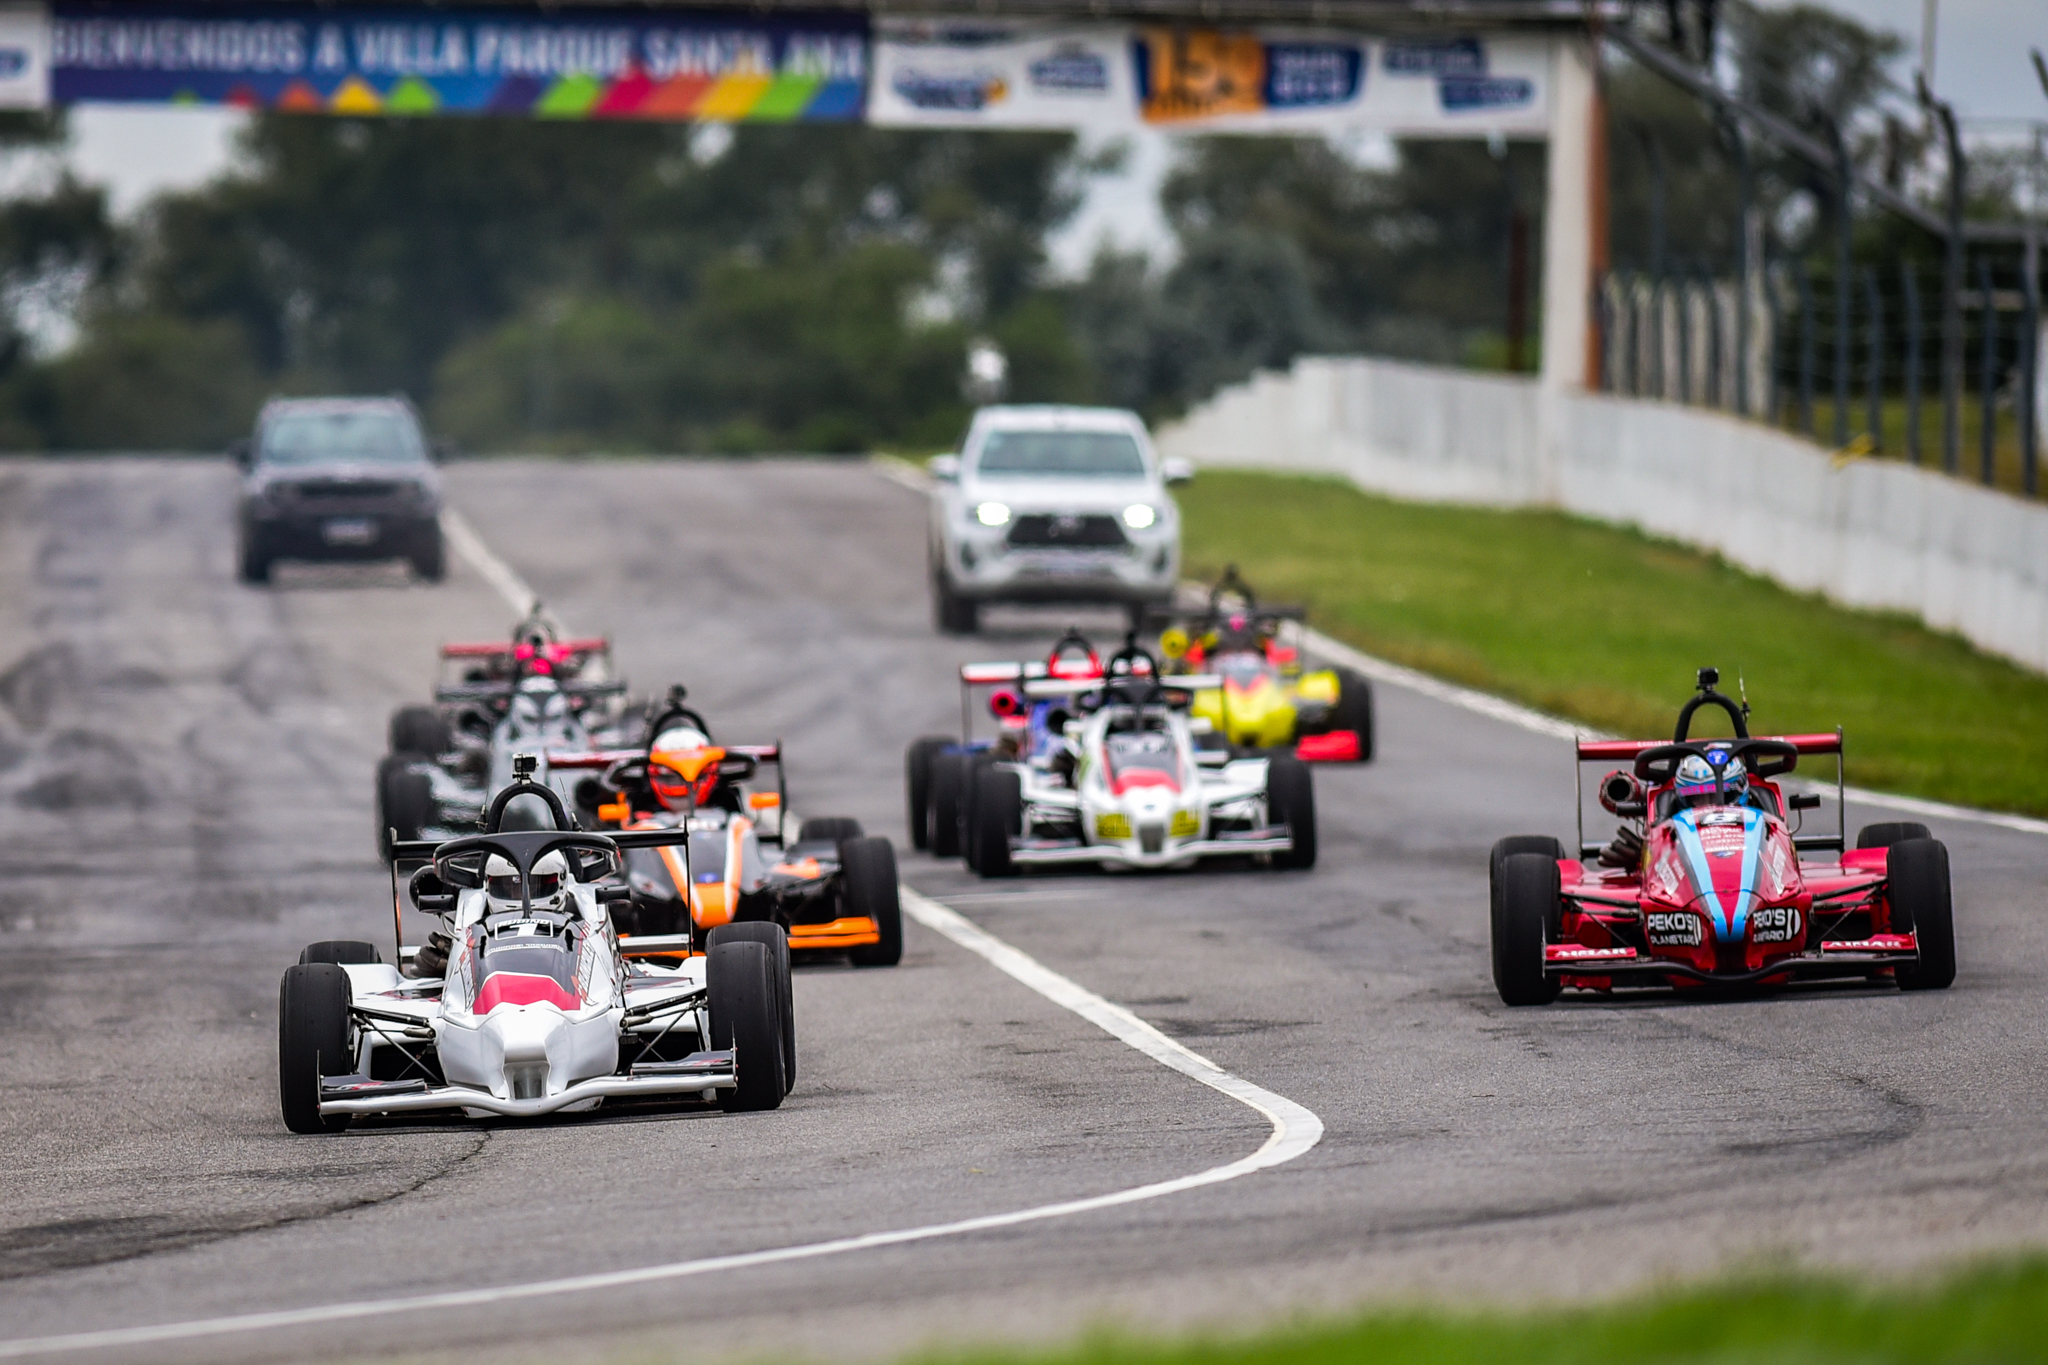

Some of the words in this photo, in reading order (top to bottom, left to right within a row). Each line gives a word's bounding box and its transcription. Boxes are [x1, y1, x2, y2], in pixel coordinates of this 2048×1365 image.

[51, 18, 305, 72] BIENVENIDOS
[312, 22, 350, 75] A
[353, 22, 470, 75] VILLA
[474, 24, 631, 79] PARQUE
[509, 924, 538, 937] 1
[1647, 912, 1695, 931] PEKO'S
